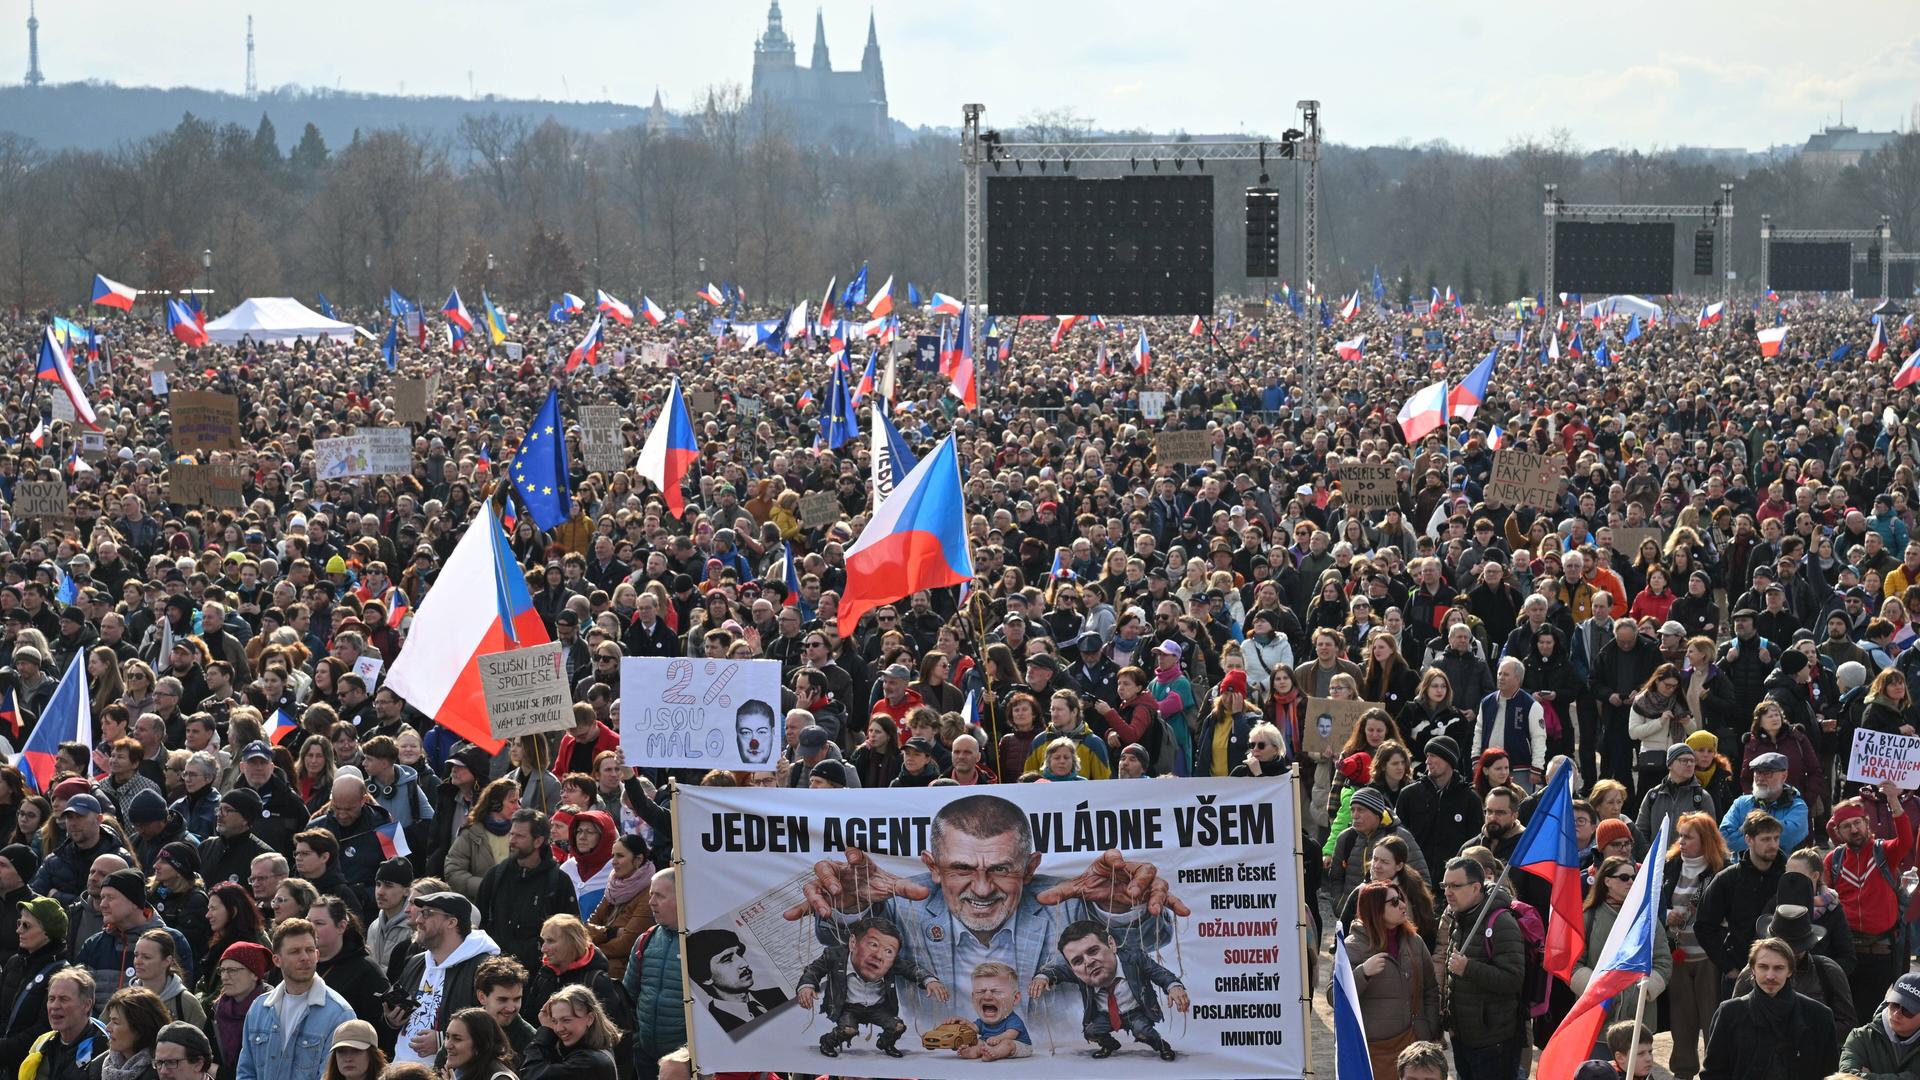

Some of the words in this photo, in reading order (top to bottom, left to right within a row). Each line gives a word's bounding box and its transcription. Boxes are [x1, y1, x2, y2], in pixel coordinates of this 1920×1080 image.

[592, 429, 612, 444] NE
[1499, 451, 1543, 469] BETON
[1377, 467, 1391, 480] SE
[1496, 465, 1531, 483] FAKT
[21, 483, 63, 497] NOVÝ
[1358, 482, 1375, 490] DO
[24, 496, 65, 513] JIČÍN
[1493, 483, 1555, 508] NEKVETE
[489, 656, 528, 675] SLUŠNÍ
[531, 698, 540, 708] SE
[542, 694, 562, 707] PROTI
[496, 716, 513, 729] VÁM
[516, 713, 526, 726] UŽ
[529, 709, 561, 725] SPOLČILI
[635, 706, 705, 732] JSOU
[1857, 731, 1876, 744] UŽ
[1879, 734, 1906, 749] BYLO
[1865, 743, 1909, 761] NIČENÍ
[1861, 766, 1908, 782] HRANIC
[701, 812, 811, 853] JEDEN
[823, 816, 932, 857] AGENT
[1029, 800, 1163, 854] VLÁDNE
[1174, 794, 1275, 849] VŠEM
[1178, 864, 1234, 884] PREMIÉR
[1237, 862, 1277, 882] ČESKÉ
[1210, 893, 1277, 910] REPUBLIKY
[1198, 918, 1278, 938] OBŽALOVANÝ
[1224, 945, 1279, 965] SOUZENÝ
[1214, 972, 1281, 992] CHRÁNĚNÝ
[1898, 982, 1920, 998] adida
[1192, 1003, 1282, 1020] POSLANECKOU
[1221, 1030, 1282, 1047] IMUNITOU
